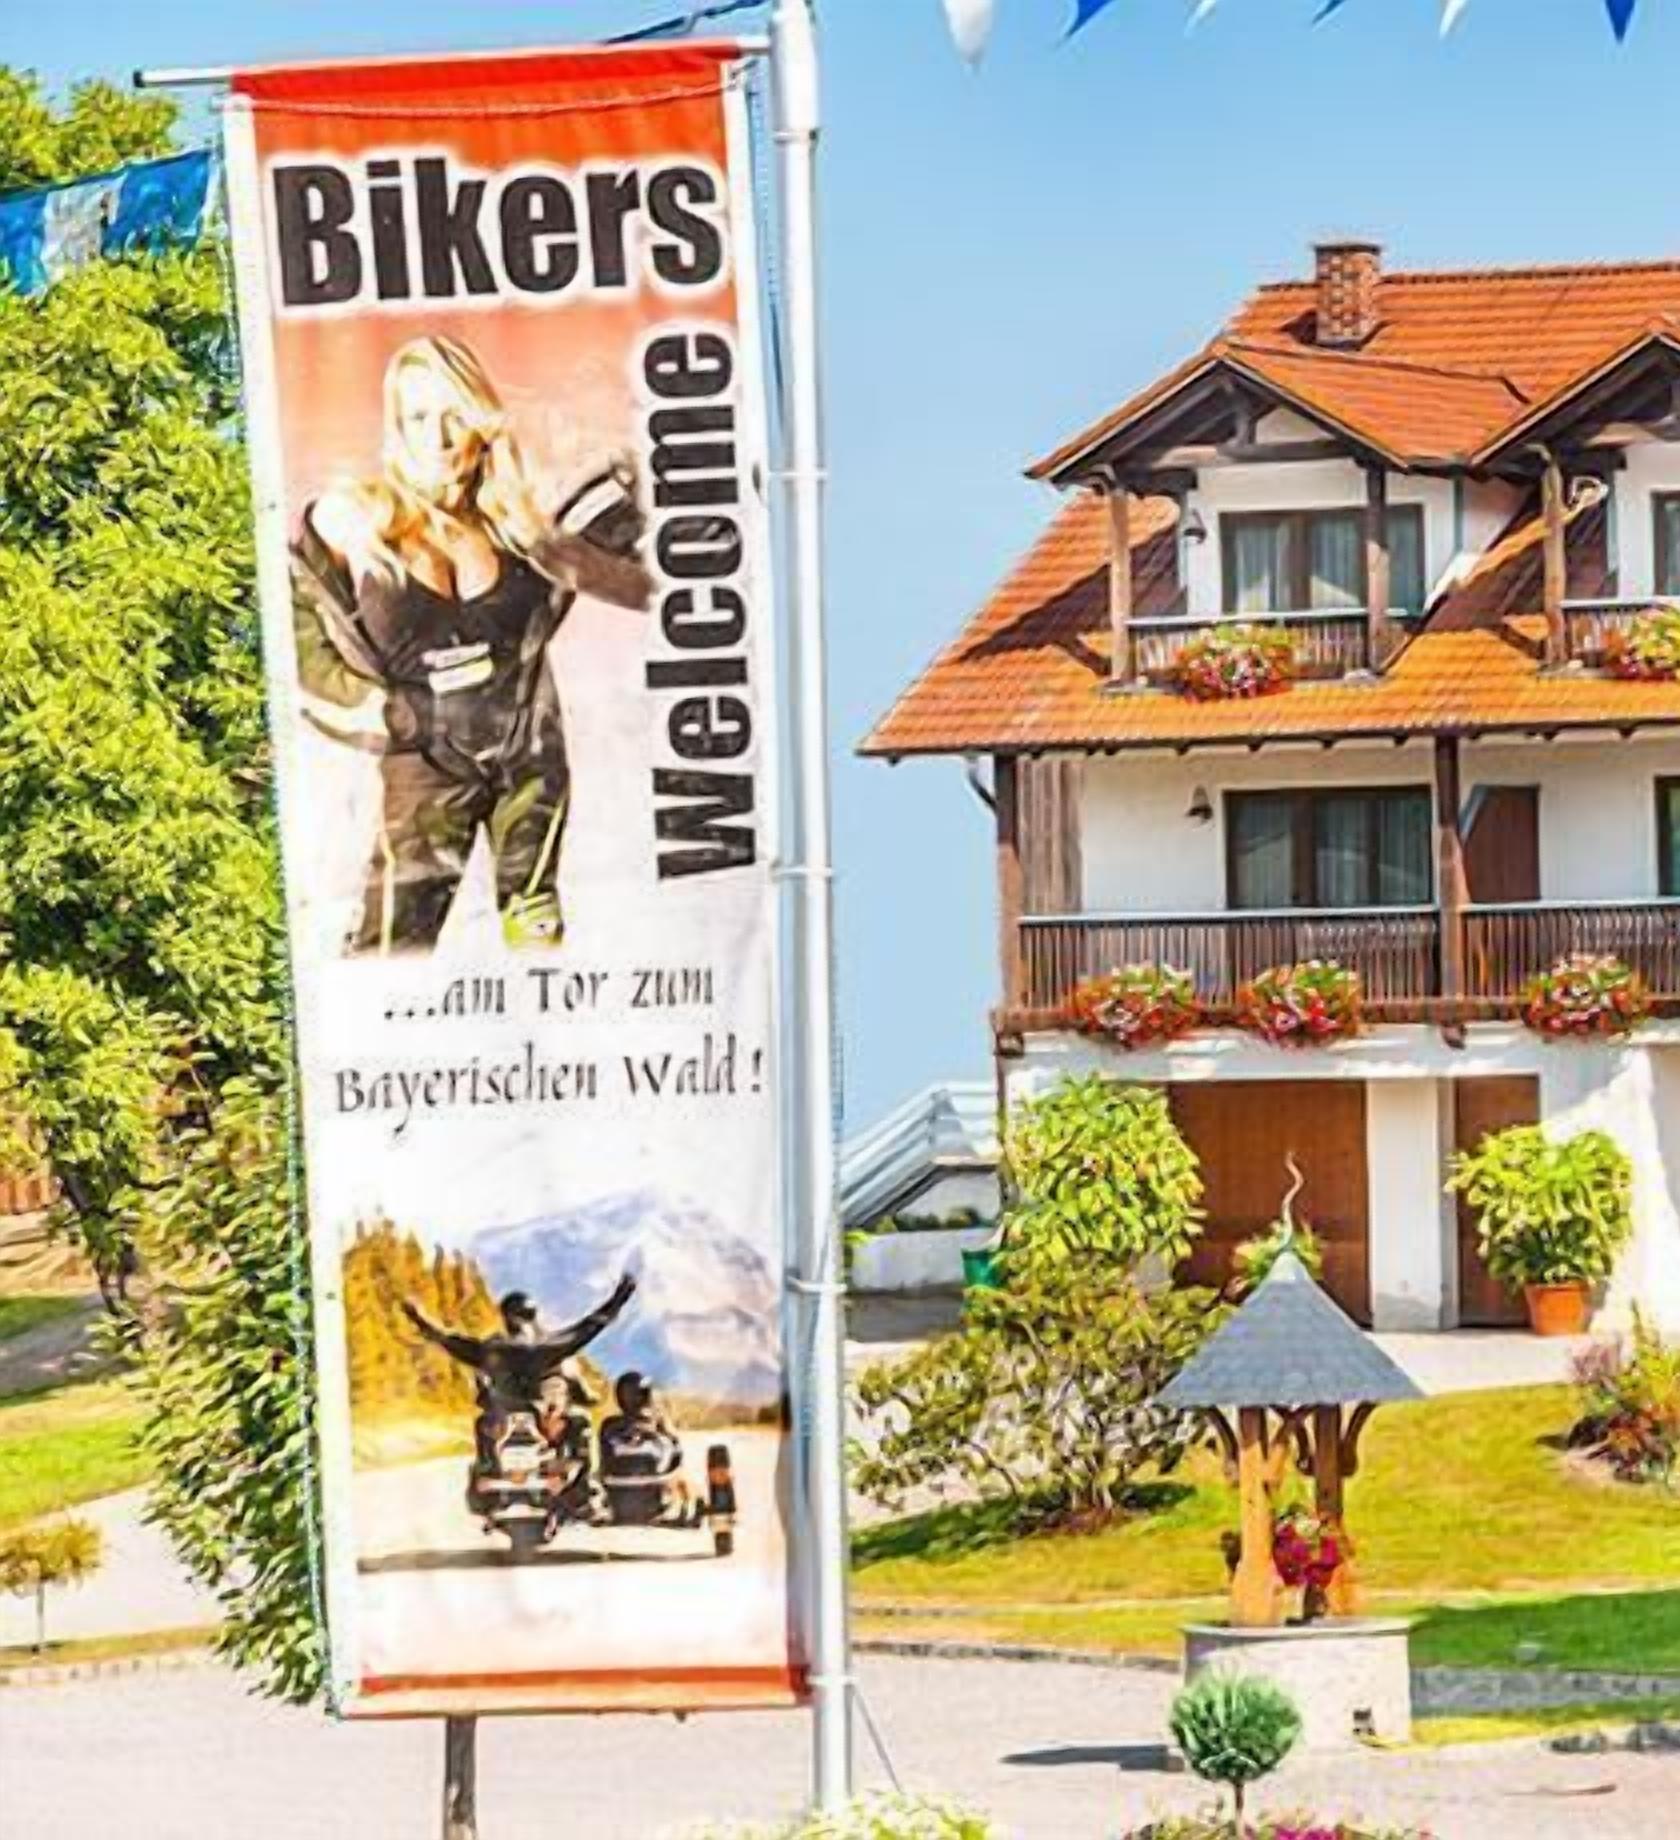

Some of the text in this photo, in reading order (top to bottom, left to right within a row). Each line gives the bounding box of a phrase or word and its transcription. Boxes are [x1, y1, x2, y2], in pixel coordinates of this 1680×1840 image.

[273, 157, 721, 305] Bikers
[645, 332, 758, 880] Welcome
[527, 967, 608, 1014] Tor
[629, 965, 714, 1008] zum
[334, 1040, 598, 1135] Bayerischen
